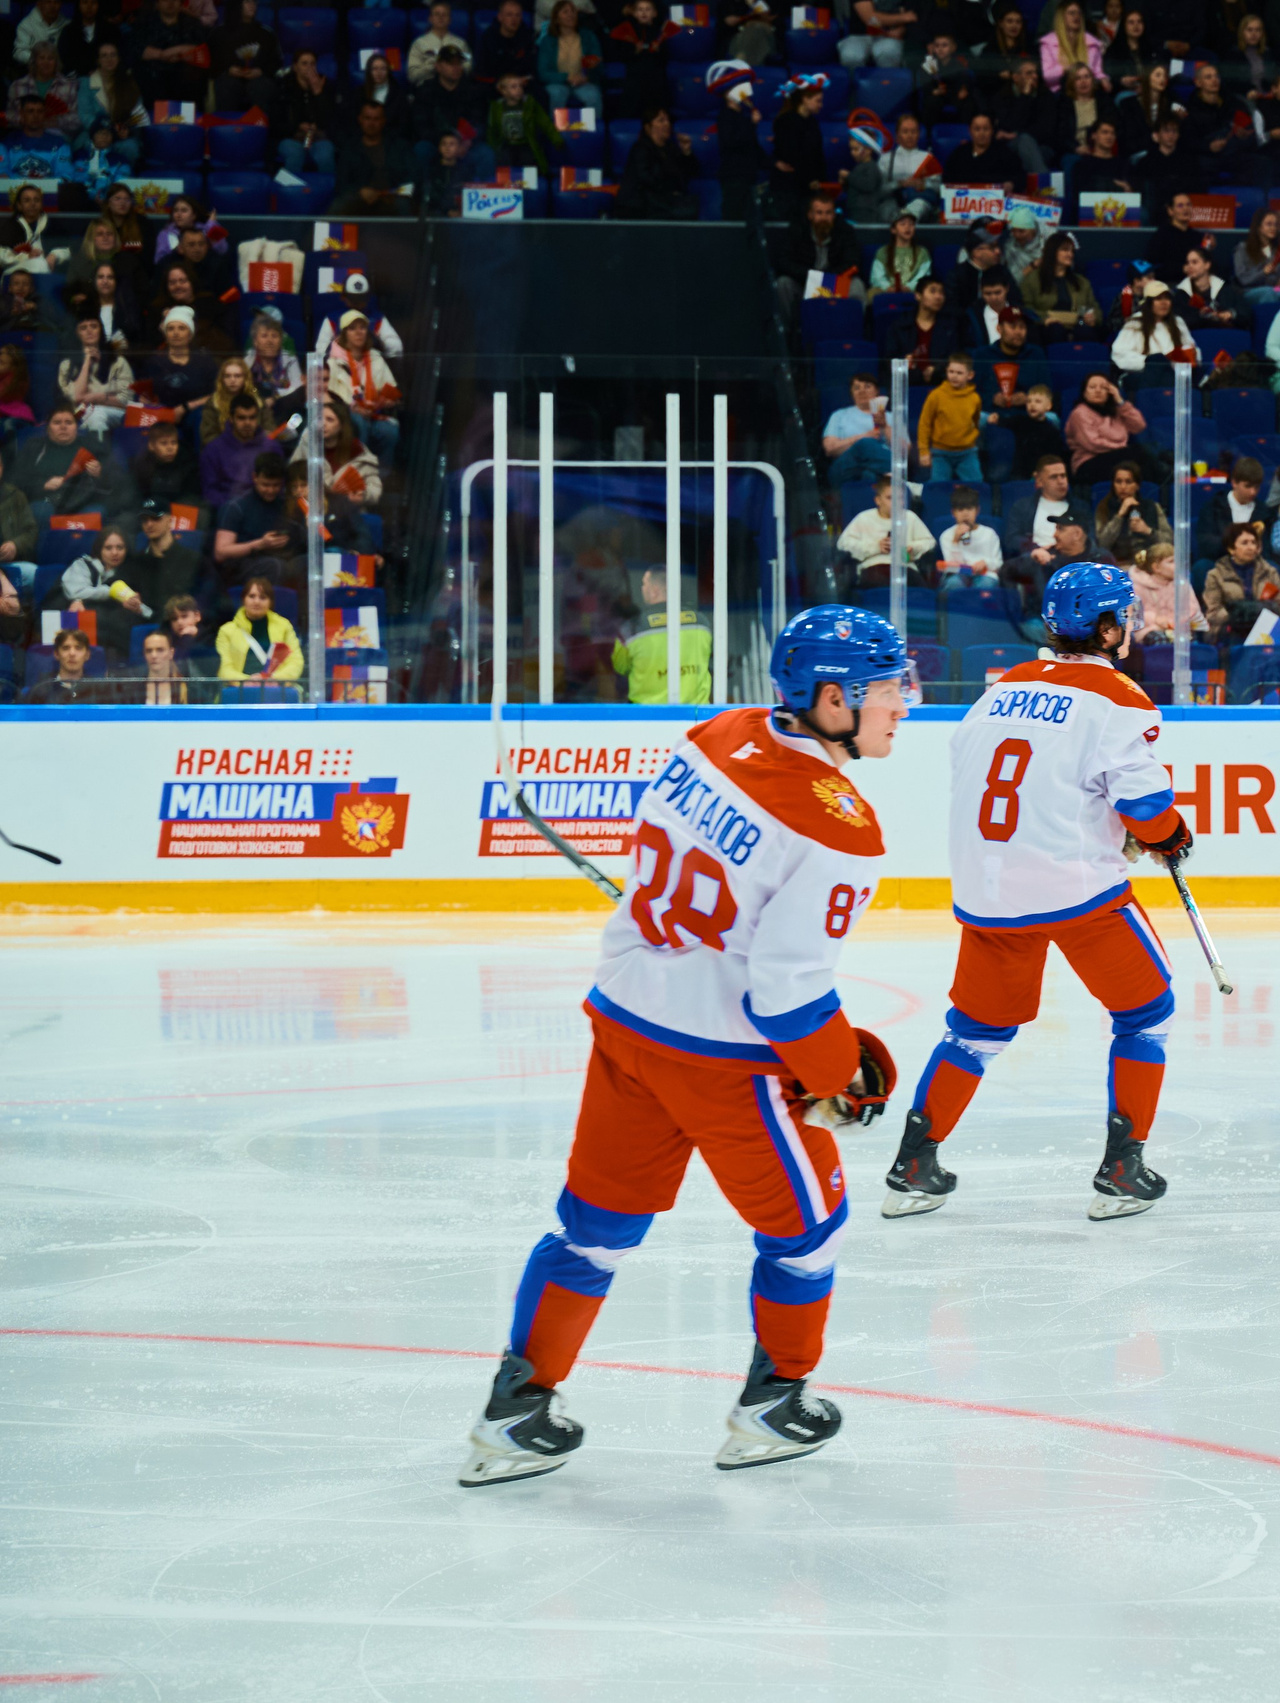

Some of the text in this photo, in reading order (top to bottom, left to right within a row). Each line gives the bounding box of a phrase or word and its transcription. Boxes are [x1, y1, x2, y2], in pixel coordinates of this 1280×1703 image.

[1097, 599, 1119, 607] CCM
[813, 665, 850, 674] CCM
[989, 691, 1073, 724] БОРИСОВ
[176, 748, 313, 776] КРАСНАЯ
[978, 738, 1033, 842] 8
[168, 784, 314, 819] МАШИНА
[171, 823, 320, 839] НАЦИОНАЛЬНАЯ ПРОГРАММА
[169, 840, 237, 856] ПОДГОТОВКИ
